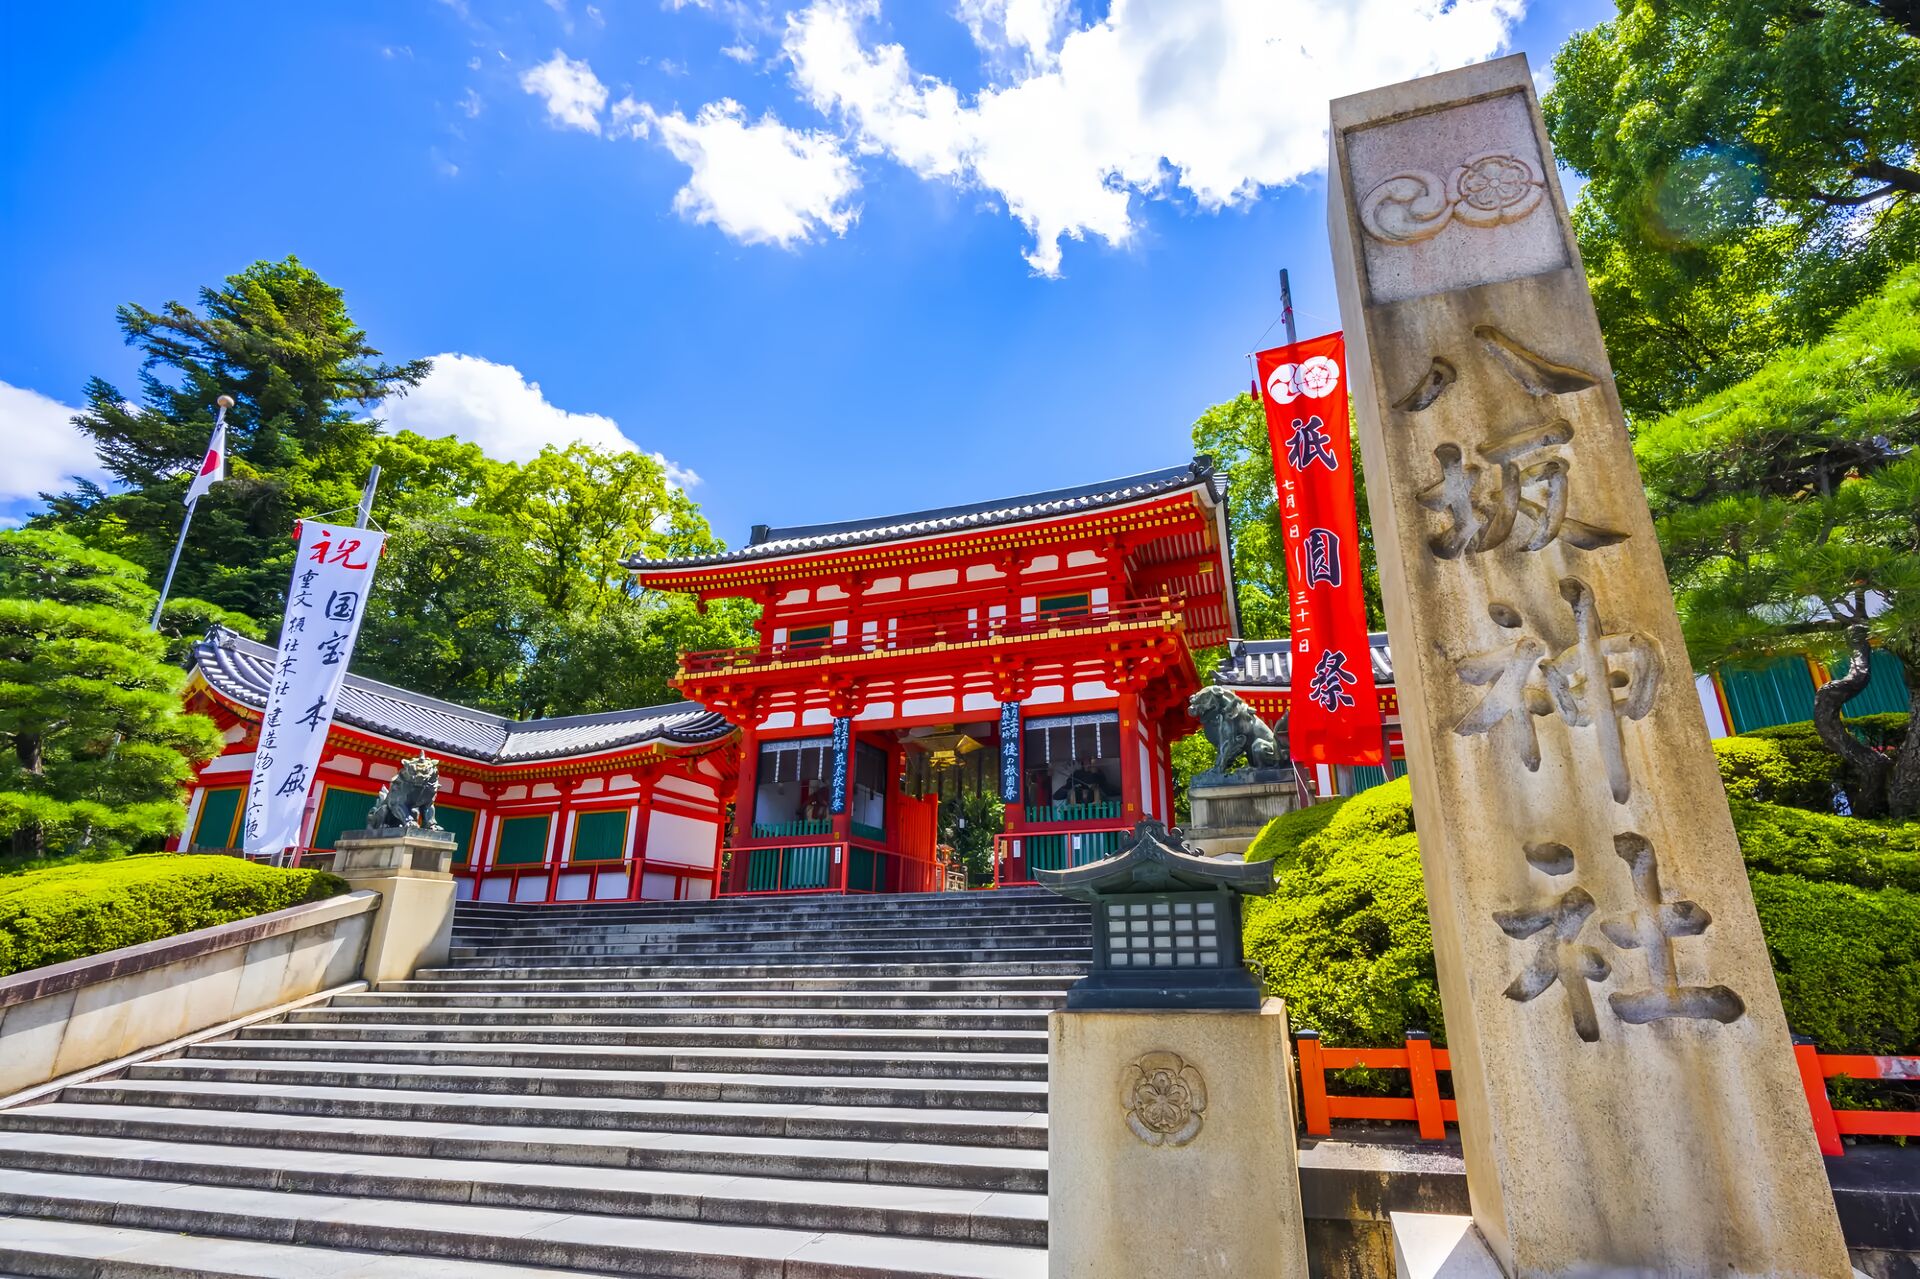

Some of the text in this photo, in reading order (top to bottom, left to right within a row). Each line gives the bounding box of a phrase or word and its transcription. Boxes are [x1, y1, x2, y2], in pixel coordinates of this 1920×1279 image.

[309, 530, 369, 570] 祝
[1285, 414, 1359, 713] 祇園祭
[276, 590, 359, 799] 国宝本殿
[1392, 323, 1746, 1044] 八坂神社
